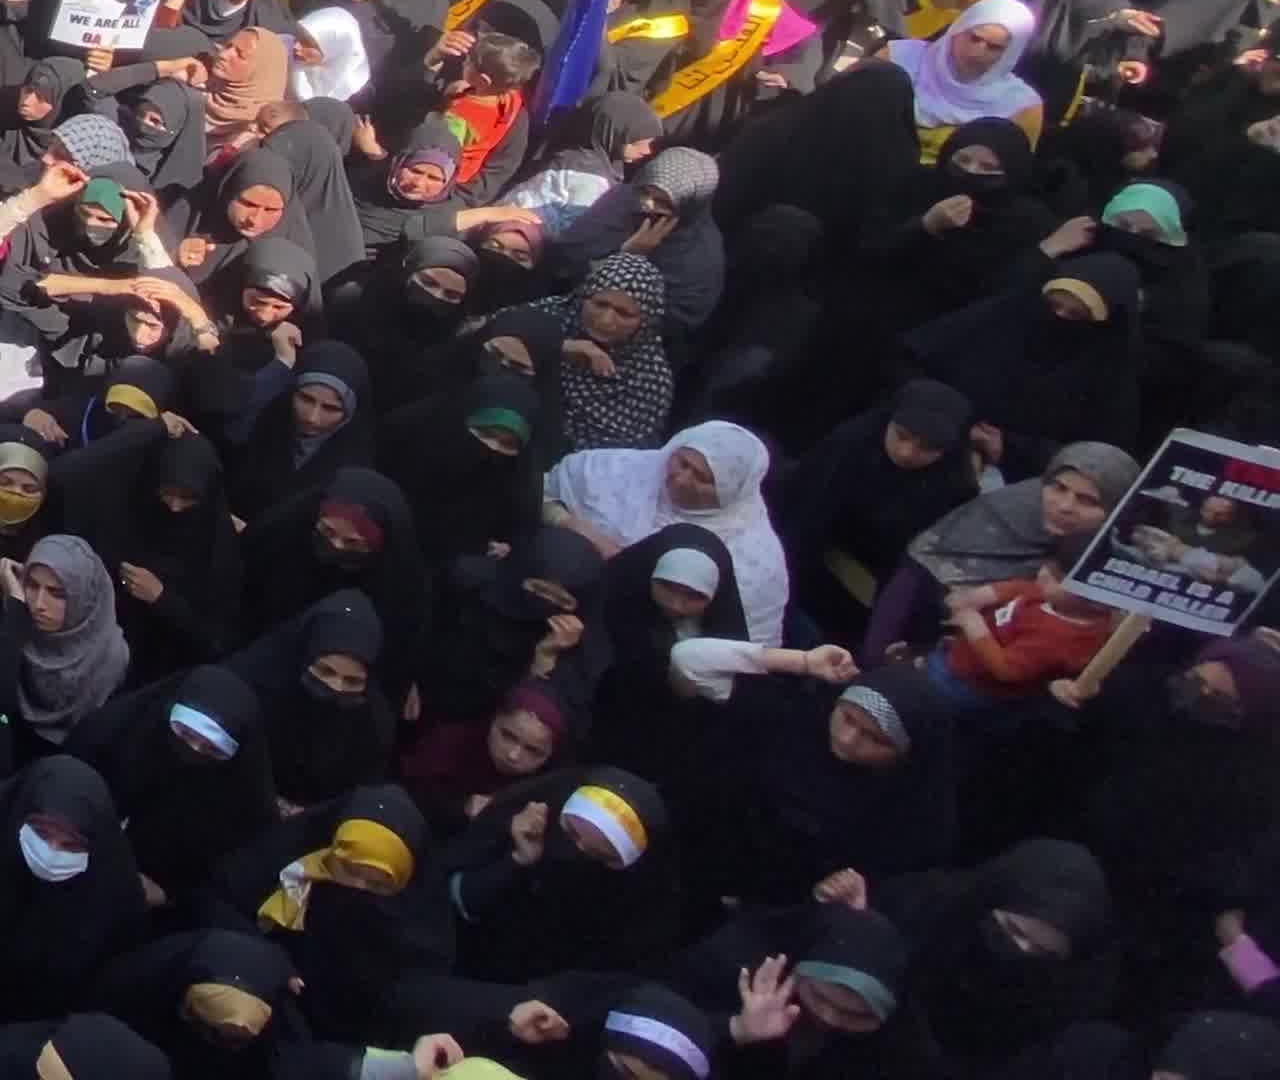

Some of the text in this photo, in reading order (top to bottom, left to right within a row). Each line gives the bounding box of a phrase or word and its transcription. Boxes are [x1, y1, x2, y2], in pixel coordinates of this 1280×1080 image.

[69, 13, 142, 29] WE ARE ALL
